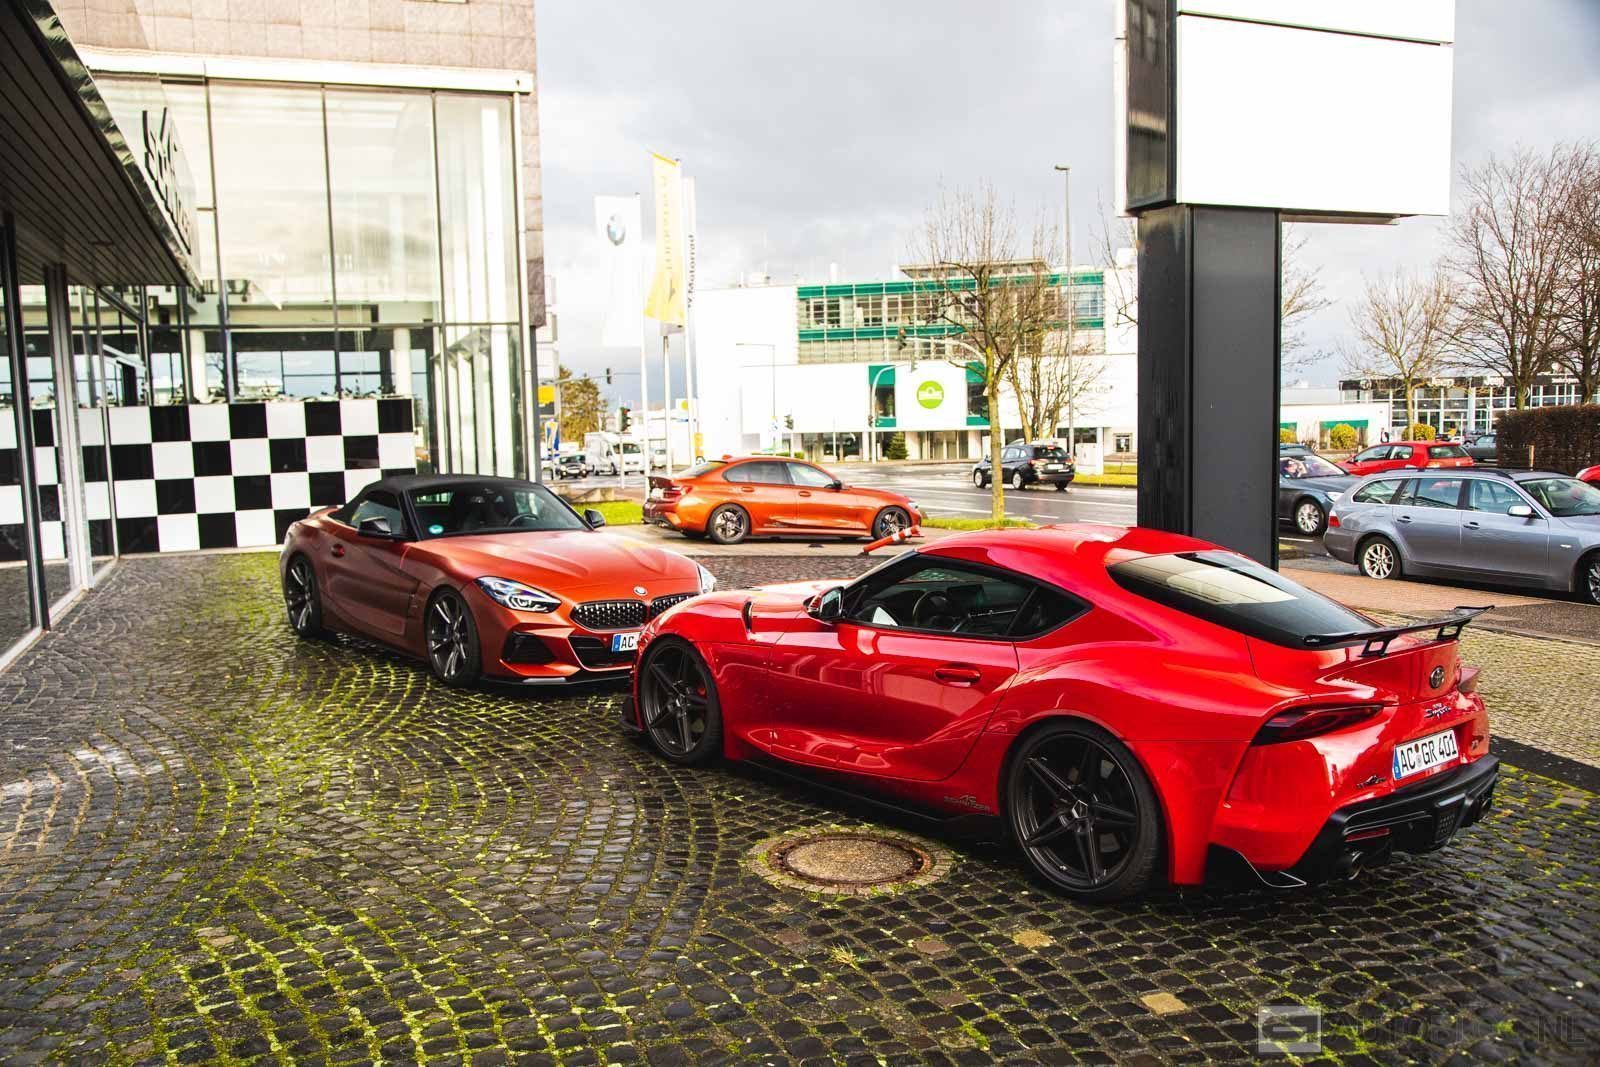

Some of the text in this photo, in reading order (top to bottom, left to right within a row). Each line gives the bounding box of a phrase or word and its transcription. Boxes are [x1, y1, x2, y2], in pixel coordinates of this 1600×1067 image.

[620, 636, 634, 648] AC
[1401, 733, 1457, 773] AC GR 401
